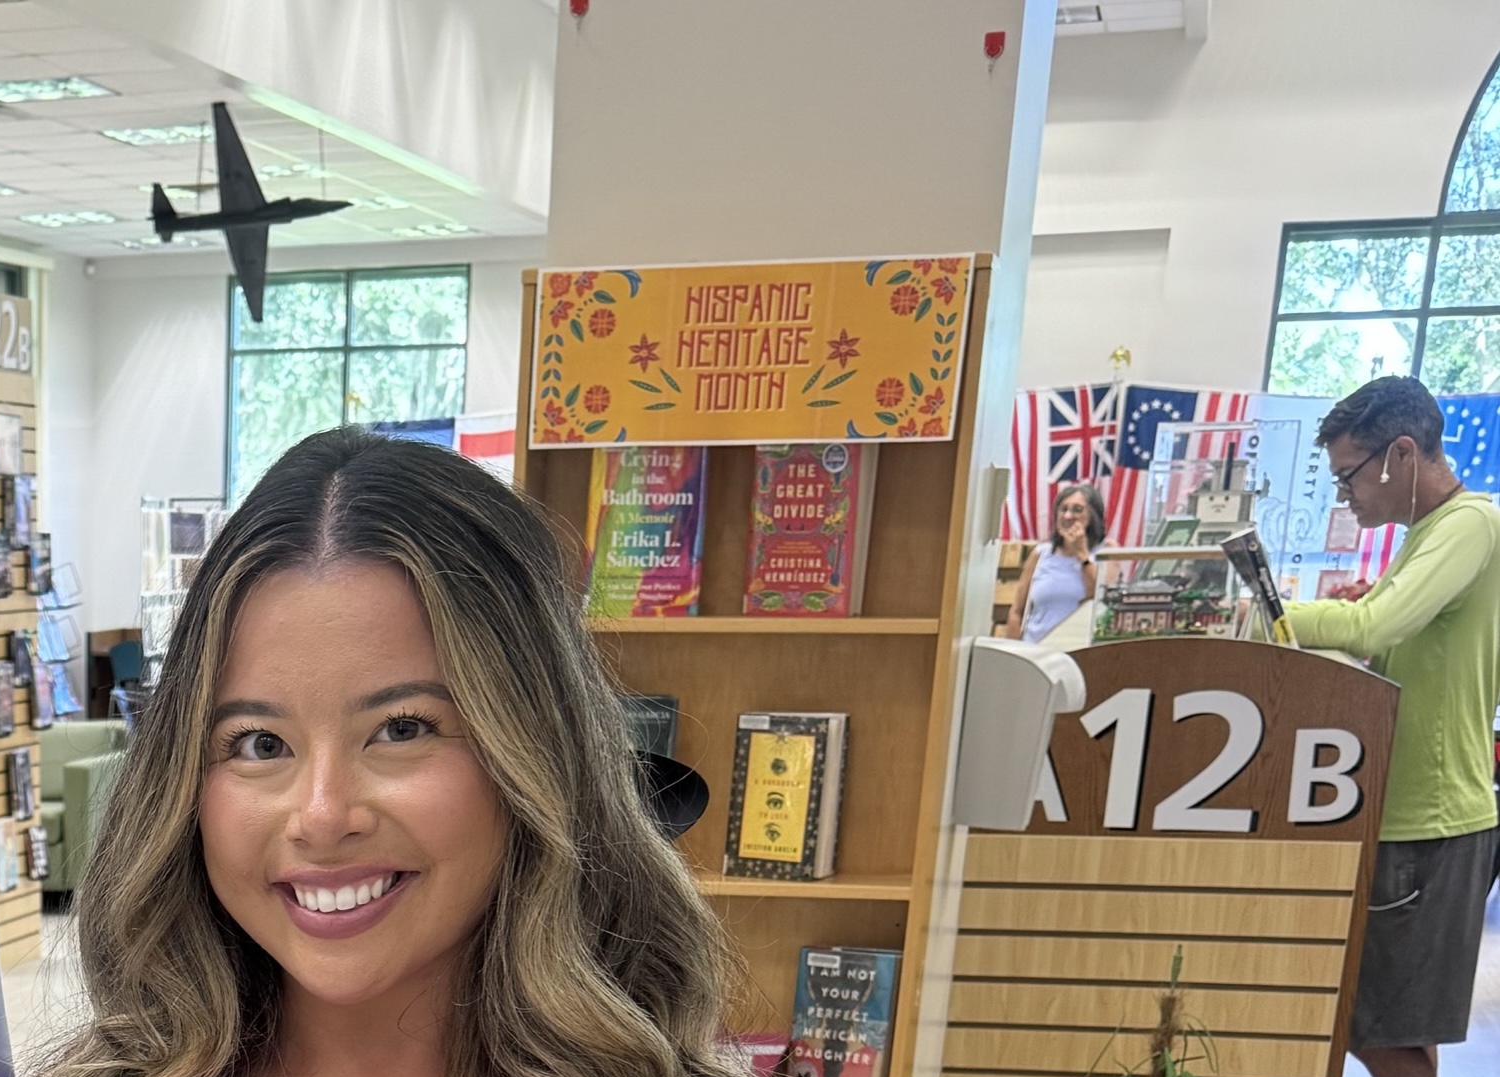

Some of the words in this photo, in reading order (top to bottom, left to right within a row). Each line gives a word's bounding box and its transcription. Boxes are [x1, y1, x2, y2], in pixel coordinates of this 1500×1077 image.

[684, 283, 813, 324] HISPANIC
[676, 326, 814, 369] HERITAGE
[695, 371, 786, 412] MONTH
[620, 451, 683, 475] Crying
[788, 464, 816, 478] THE
[646, 474, 666, 484] the
[603, 489, 694, 505] Bathroom
[776, 484, 825, 498] GREAT
[628, 512, 675, 523] Memoir
[774, 504, 825, 519] DIVIDE
[611, 530, 659, 547] Erika
[664, 531, 682, 547] L.
[606, 550, 680, 568] Sánchez
[820, 968, 841, 977] AM
[847, 970, 876, 981] NOT
[821, 988, 860, 1000] YOUR
[807, 1007, 869, 1022] PERFECT
[803, 1027, 867, 1042] MEXICAN
[795, 1046, 871, 1066] DAUGHTER
